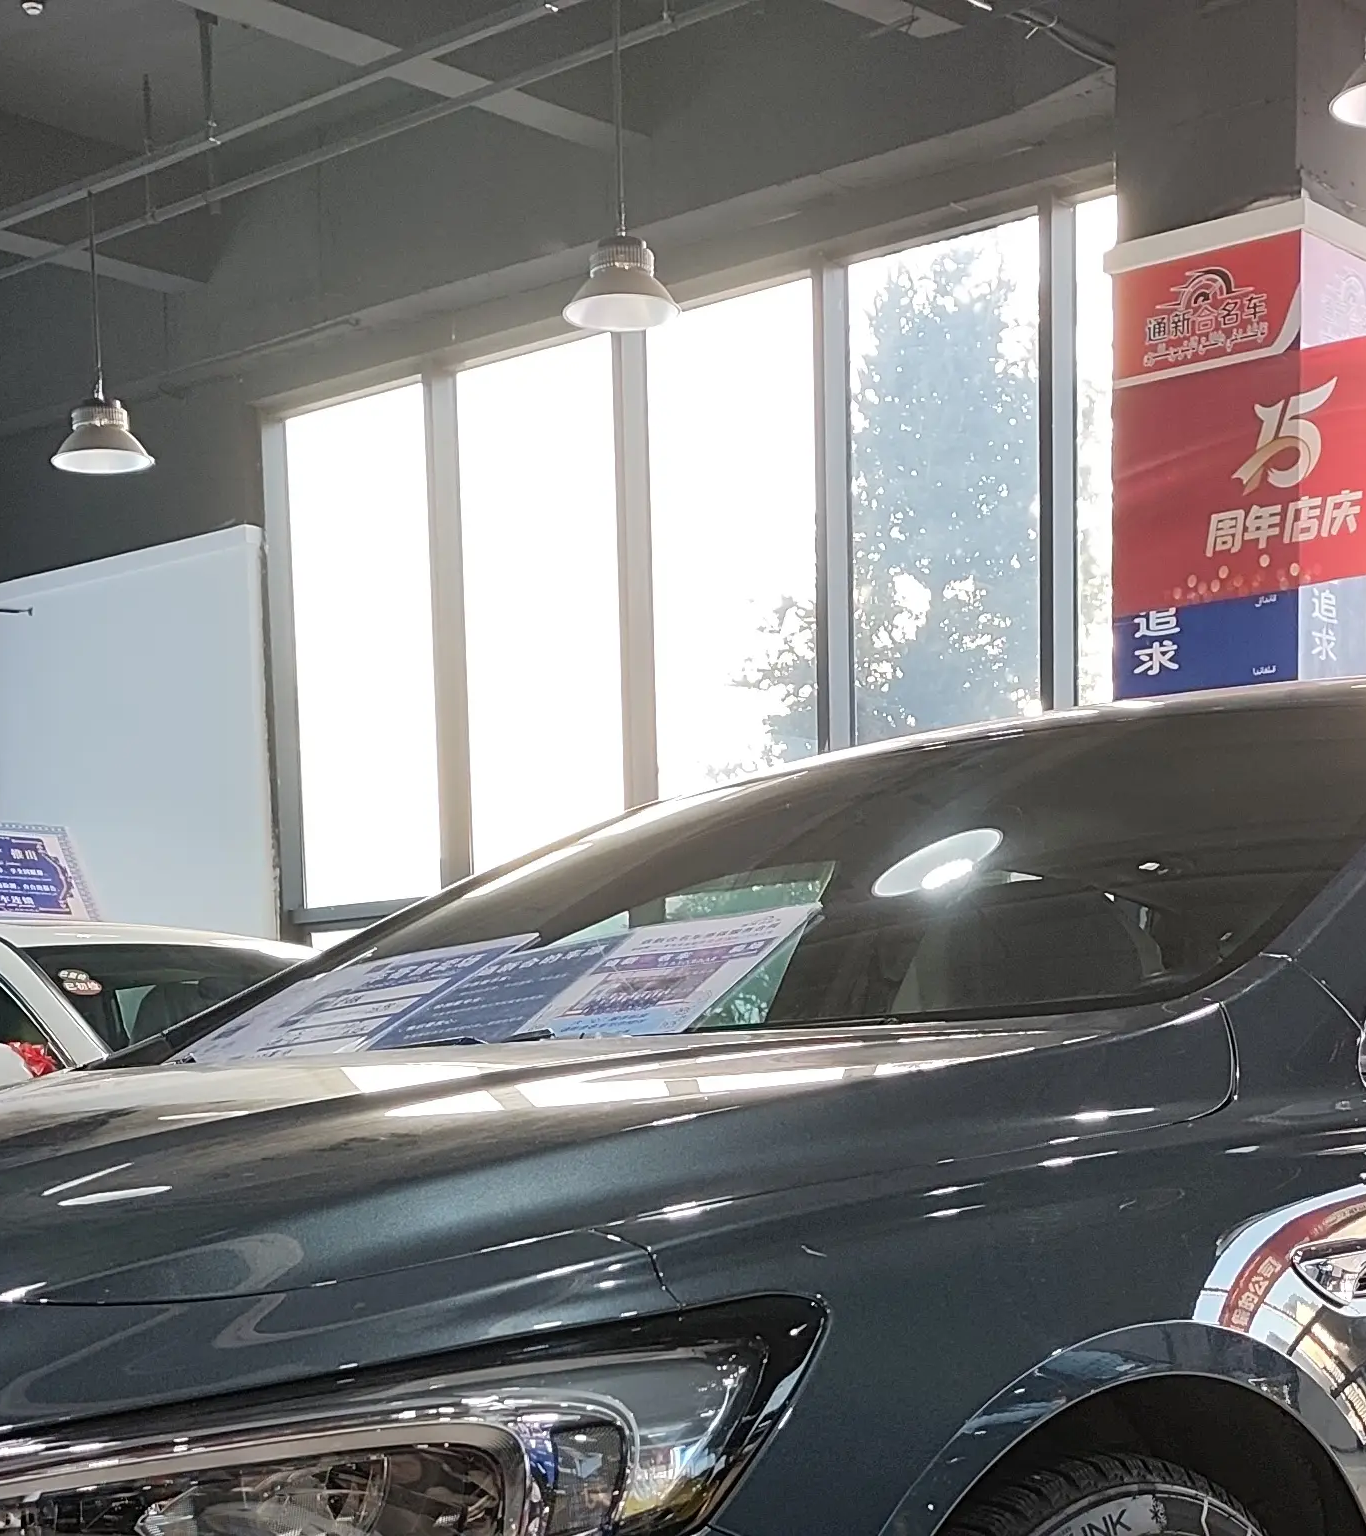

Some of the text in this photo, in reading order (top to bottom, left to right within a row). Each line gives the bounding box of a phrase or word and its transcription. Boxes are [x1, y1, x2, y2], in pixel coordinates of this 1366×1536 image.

[1144, 293, 1268, 344] 通新合名车
[1232, 377, 1337, 495] 15
[1205, 489, 1363, 557] 周年店庆
[1133, 607, 1181, 676] 追求
